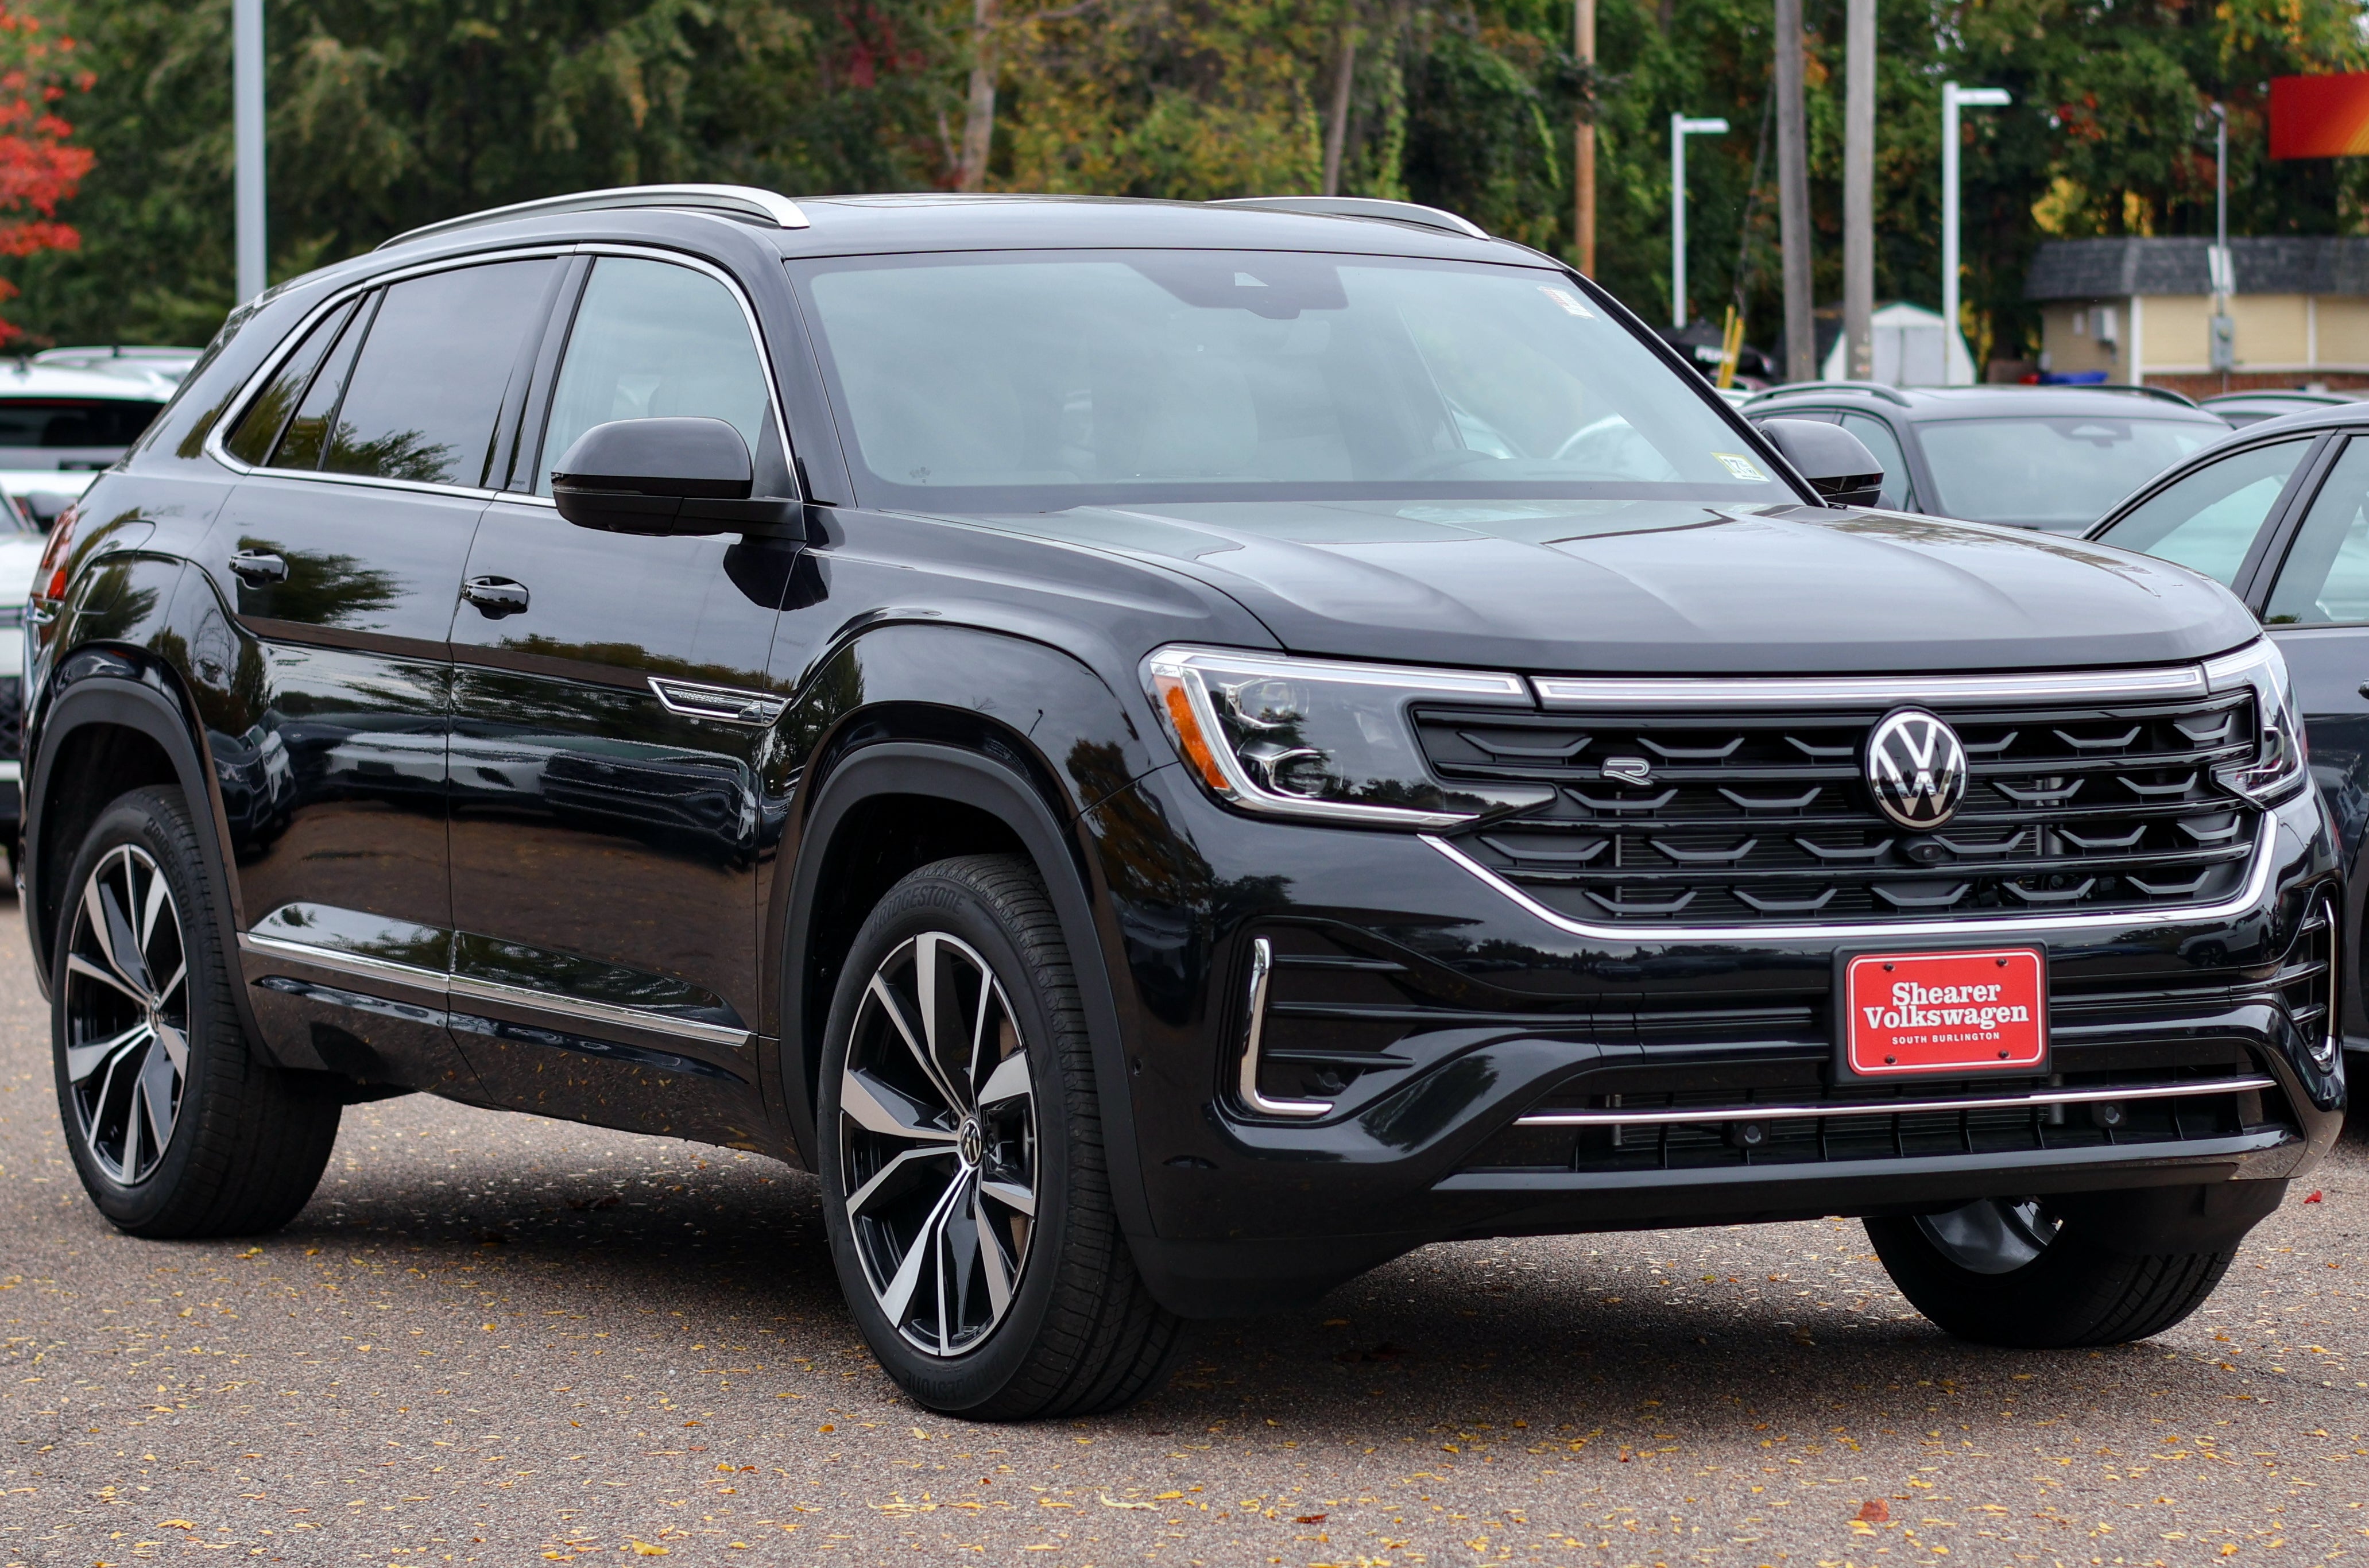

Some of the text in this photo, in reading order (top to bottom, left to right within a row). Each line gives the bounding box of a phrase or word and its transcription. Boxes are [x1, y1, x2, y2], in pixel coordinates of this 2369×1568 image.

[1603, 759, 1654, 785] R
[1876, 719, 1960, 818] VW
[869, 885, 966, 942] BRIDGESTONE
[1892, 982, 2001, 1006] Shearer
[1863, 1005, 2029, 1030] Volkswagen
[1892, 1032, 2000, 1045] SOUTH BURLINGTON
